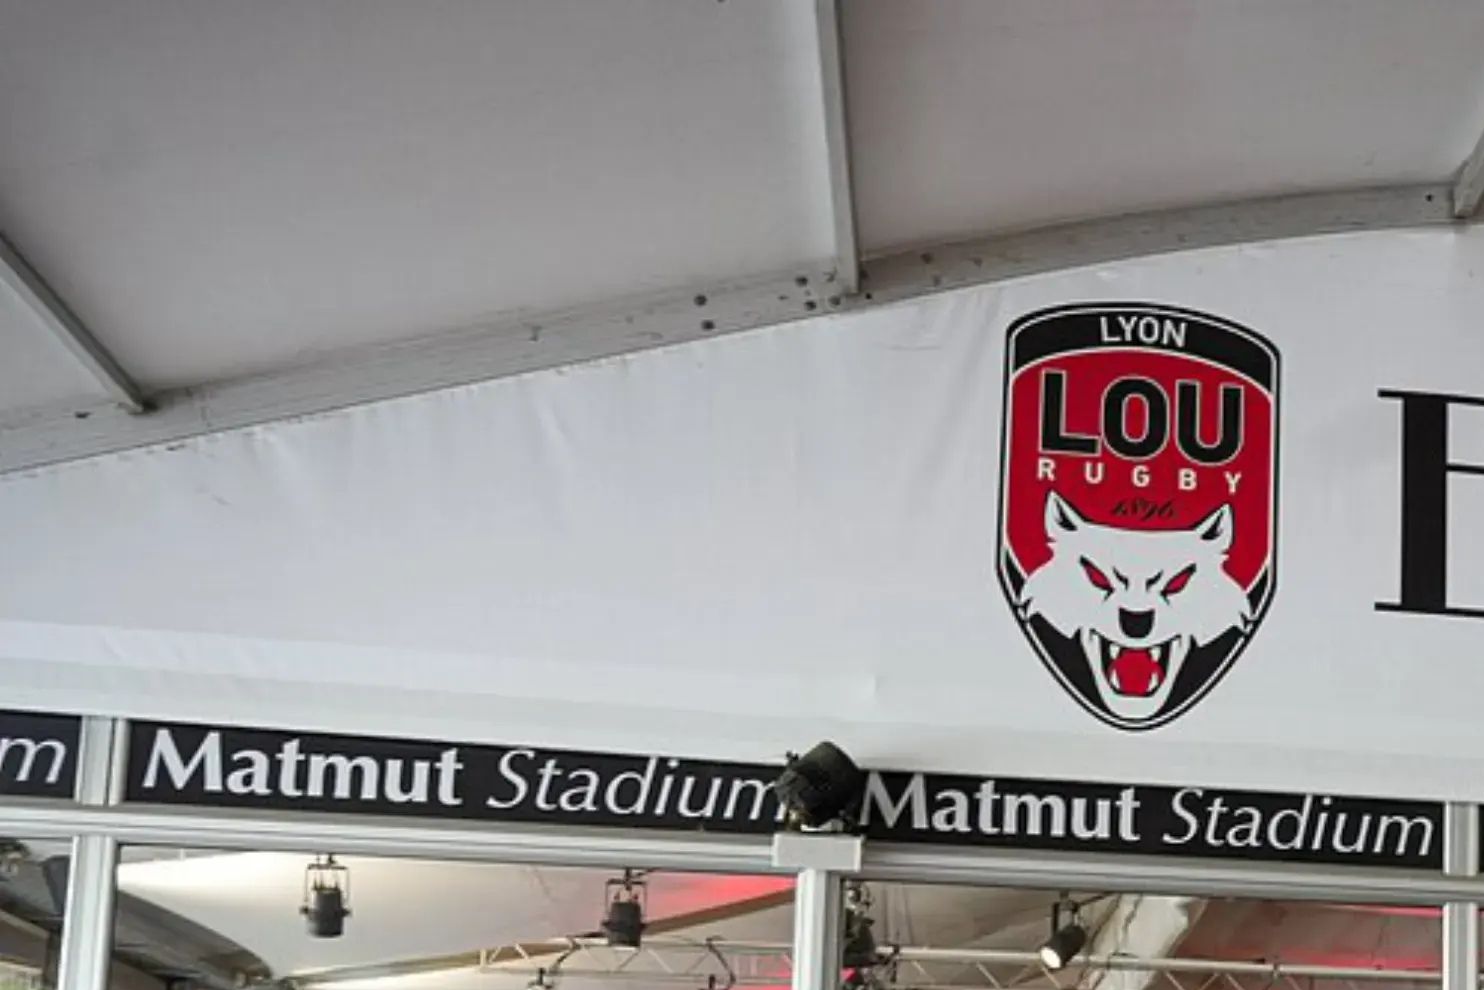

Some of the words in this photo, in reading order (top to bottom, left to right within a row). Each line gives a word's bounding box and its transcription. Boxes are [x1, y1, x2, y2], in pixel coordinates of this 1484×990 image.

[1100, 315, 1188, 347] LYON
[1039, 368, 1244, 465] LOU
[1035, 457, 1242, 494] RUGBY
[142, 727, 463, 807] Matmut
[860, 772, 1141, 842] Matmut
[1162, 787, 1434, 857] Stadium
